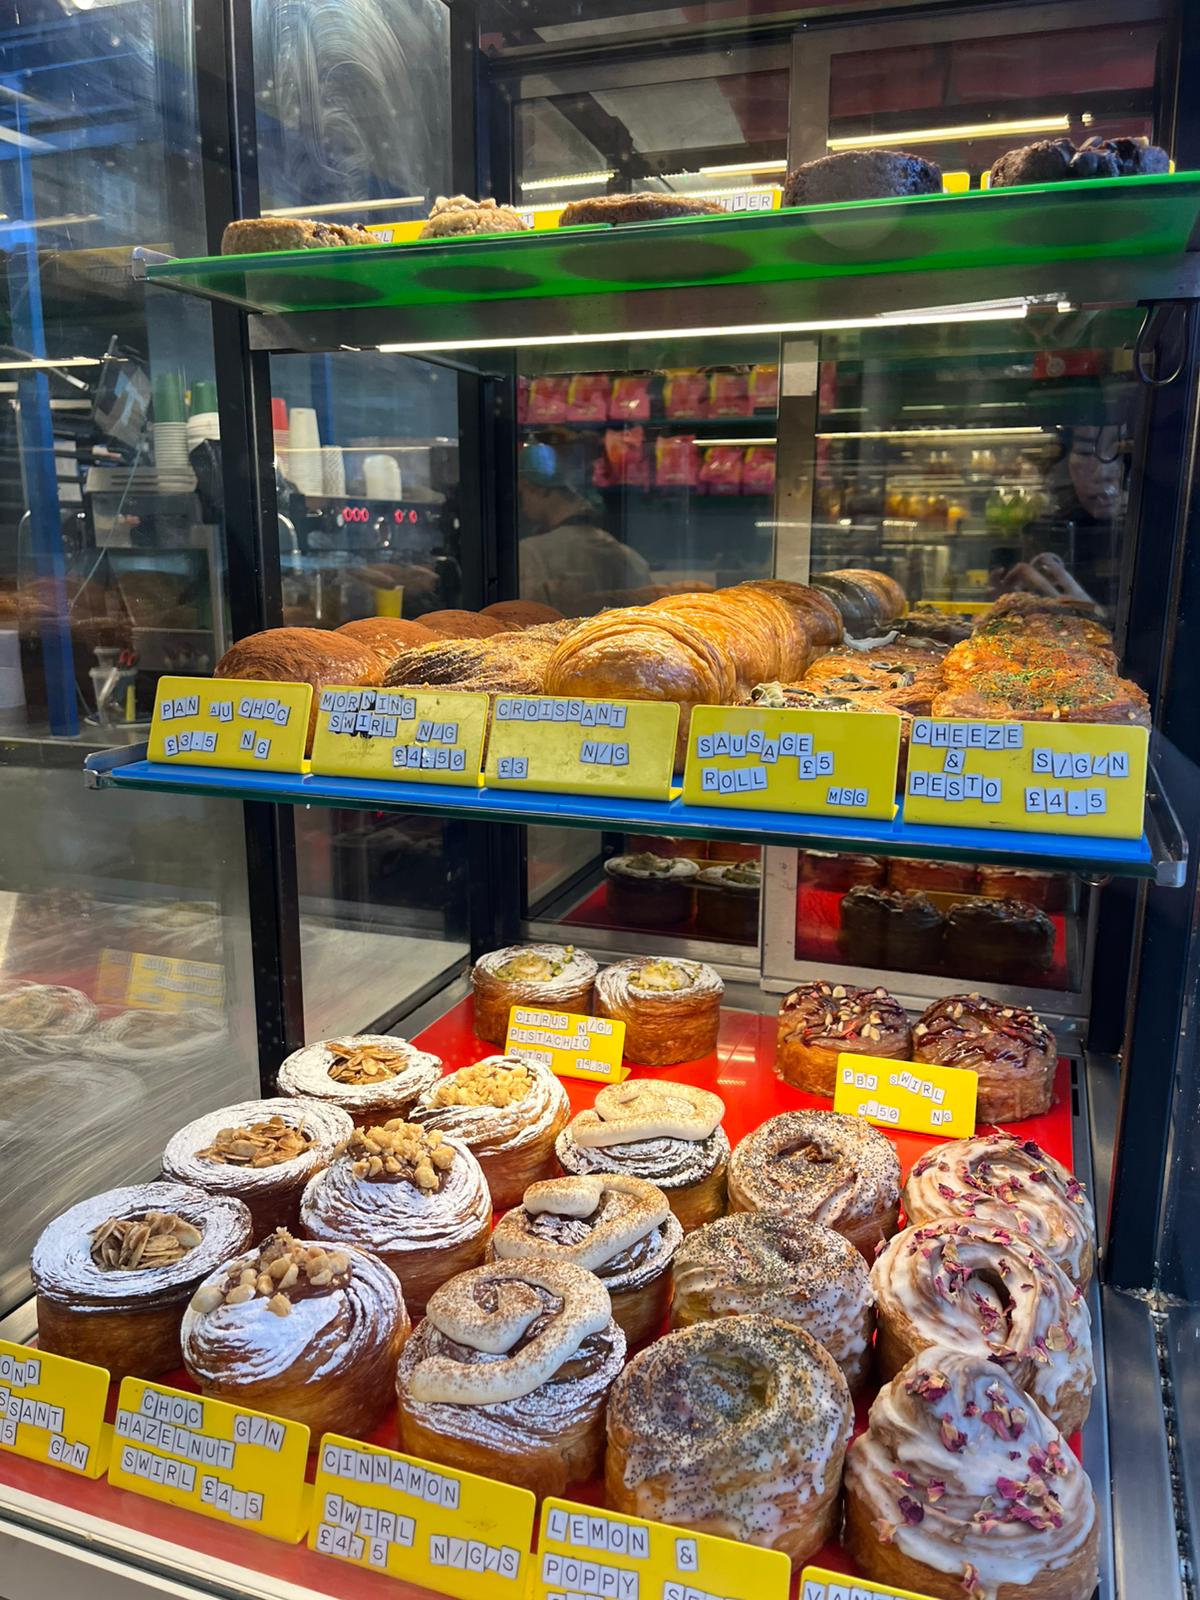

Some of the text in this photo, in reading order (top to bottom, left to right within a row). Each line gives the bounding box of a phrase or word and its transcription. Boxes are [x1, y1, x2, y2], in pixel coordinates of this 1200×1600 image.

[162, 698, 286, 722] PAN AU CHOC
[322, 694, 412, 714] MORNING
[498, 702, 623, 722] CROISSANT
[330, 714, 394, 734] SWIRL
[419, 724, 455, 739] N/G
[915, 723, 1019, 745] CHEEZE
[167, 734, 214, 752] £3.5
[583, 744, 625, 760] N/G
[700, 734, 809, 758] SAUSAGE
[395, 749, 463, 766] £4.50
[500, 759, 524, 774] £3
[803, 755, 831, 774] £5
[946, 753, 959, 769] &
[1037, 752, 1125, 776] S/G/N
[705, 771, 765, 788] ROLL
[829, 790, 865, 803] MSG
[913, 775, 1103, 811] PESTO £4.5
[515, 1010, 567, 1026] CITRUS
[510, 1028, 590, 1047] PISTACHIO
[843, 1070, 943, 1100] PBJ SWIRL
[859, 1104, 898, 1120] 4.50
[143, 1394, 281, 1446] CHOC G/N
[117, 1415, 231, 1463] HAZELNUT
[50, 1439, 85, 1465] G/N
[123, 1451, 259, 1514] SWIRL £4.5
[324, 1450, 457, 1504] CINNAMON
[327, 1499, 410, 1540] SWIRL
[551, 1513, 693, 1564] LEMON &
[435, 1543, 516, 1571] N/G/S
[546, 1558, 635, 1595] POPPY
